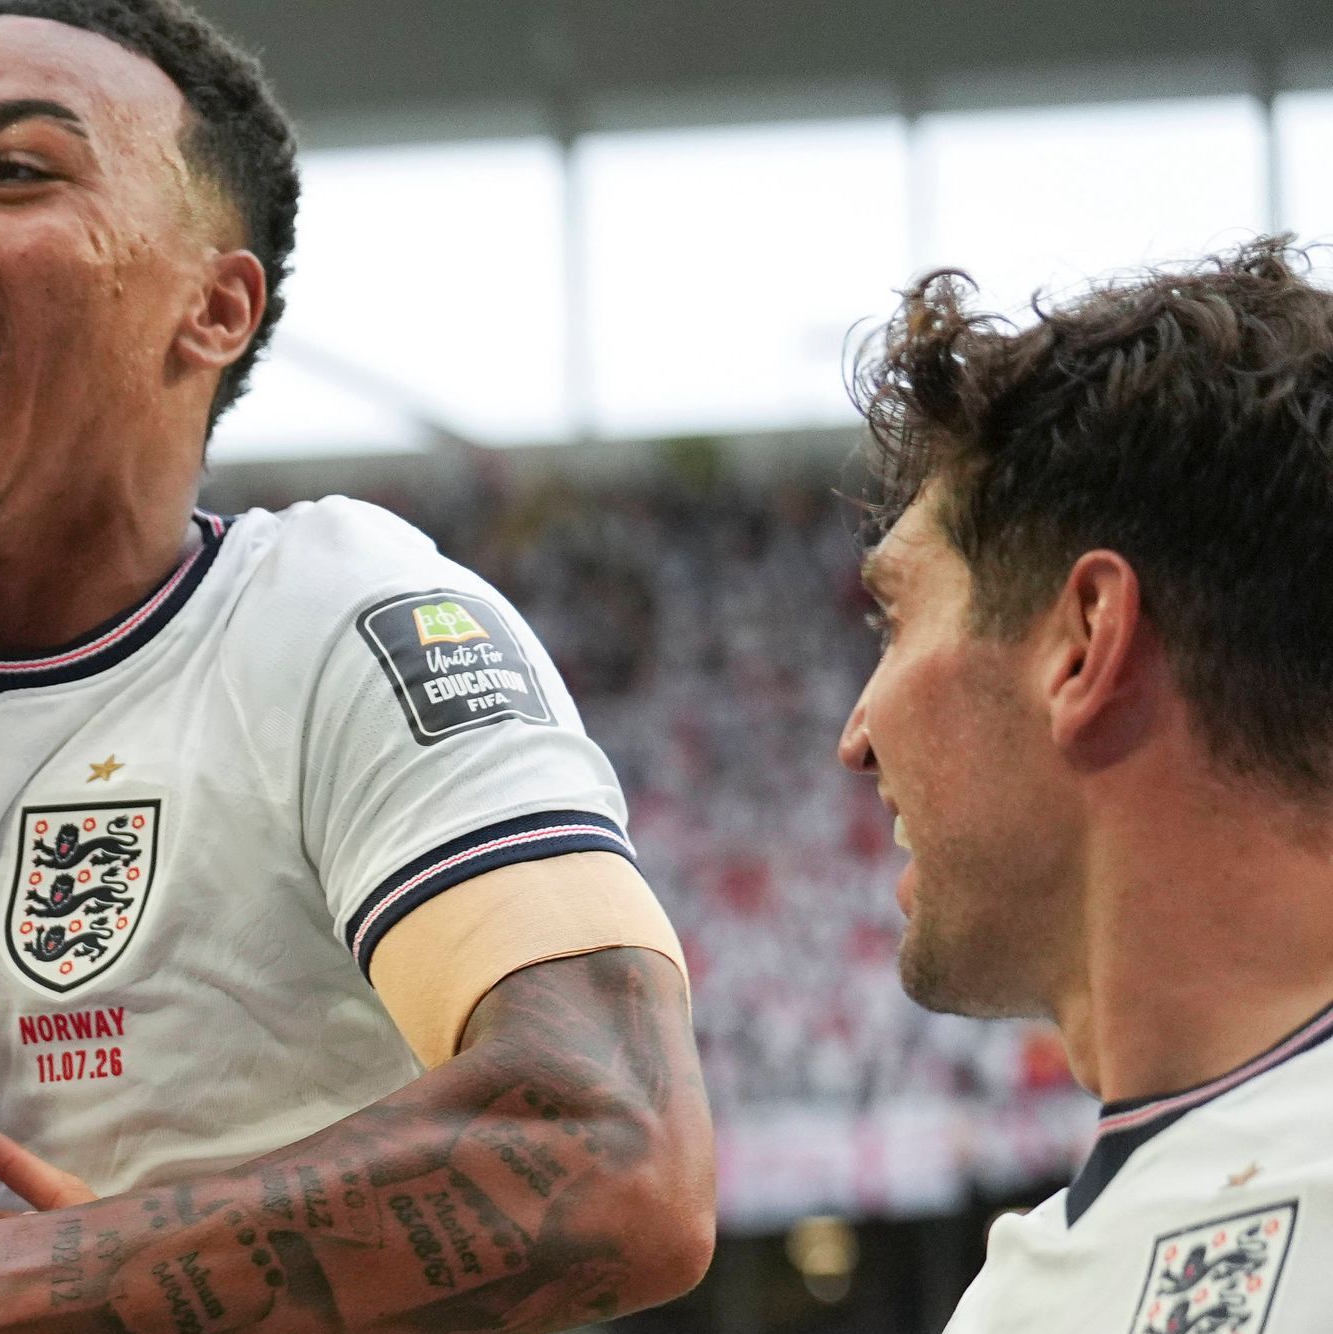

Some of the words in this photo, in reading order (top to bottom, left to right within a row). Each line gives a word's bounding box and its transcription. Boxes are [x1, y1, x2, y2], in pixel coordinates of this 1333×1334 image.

[425, 645, 477, 674] Unite
[474, 642, 504, 666] For
[422, 668, 529, 705] EDUCATION
[466, 693, 511, 713] FIFA
[18, 1006, 125, 1046] NORWAY
[36, 1046, 124, 1084] 11.07.26
